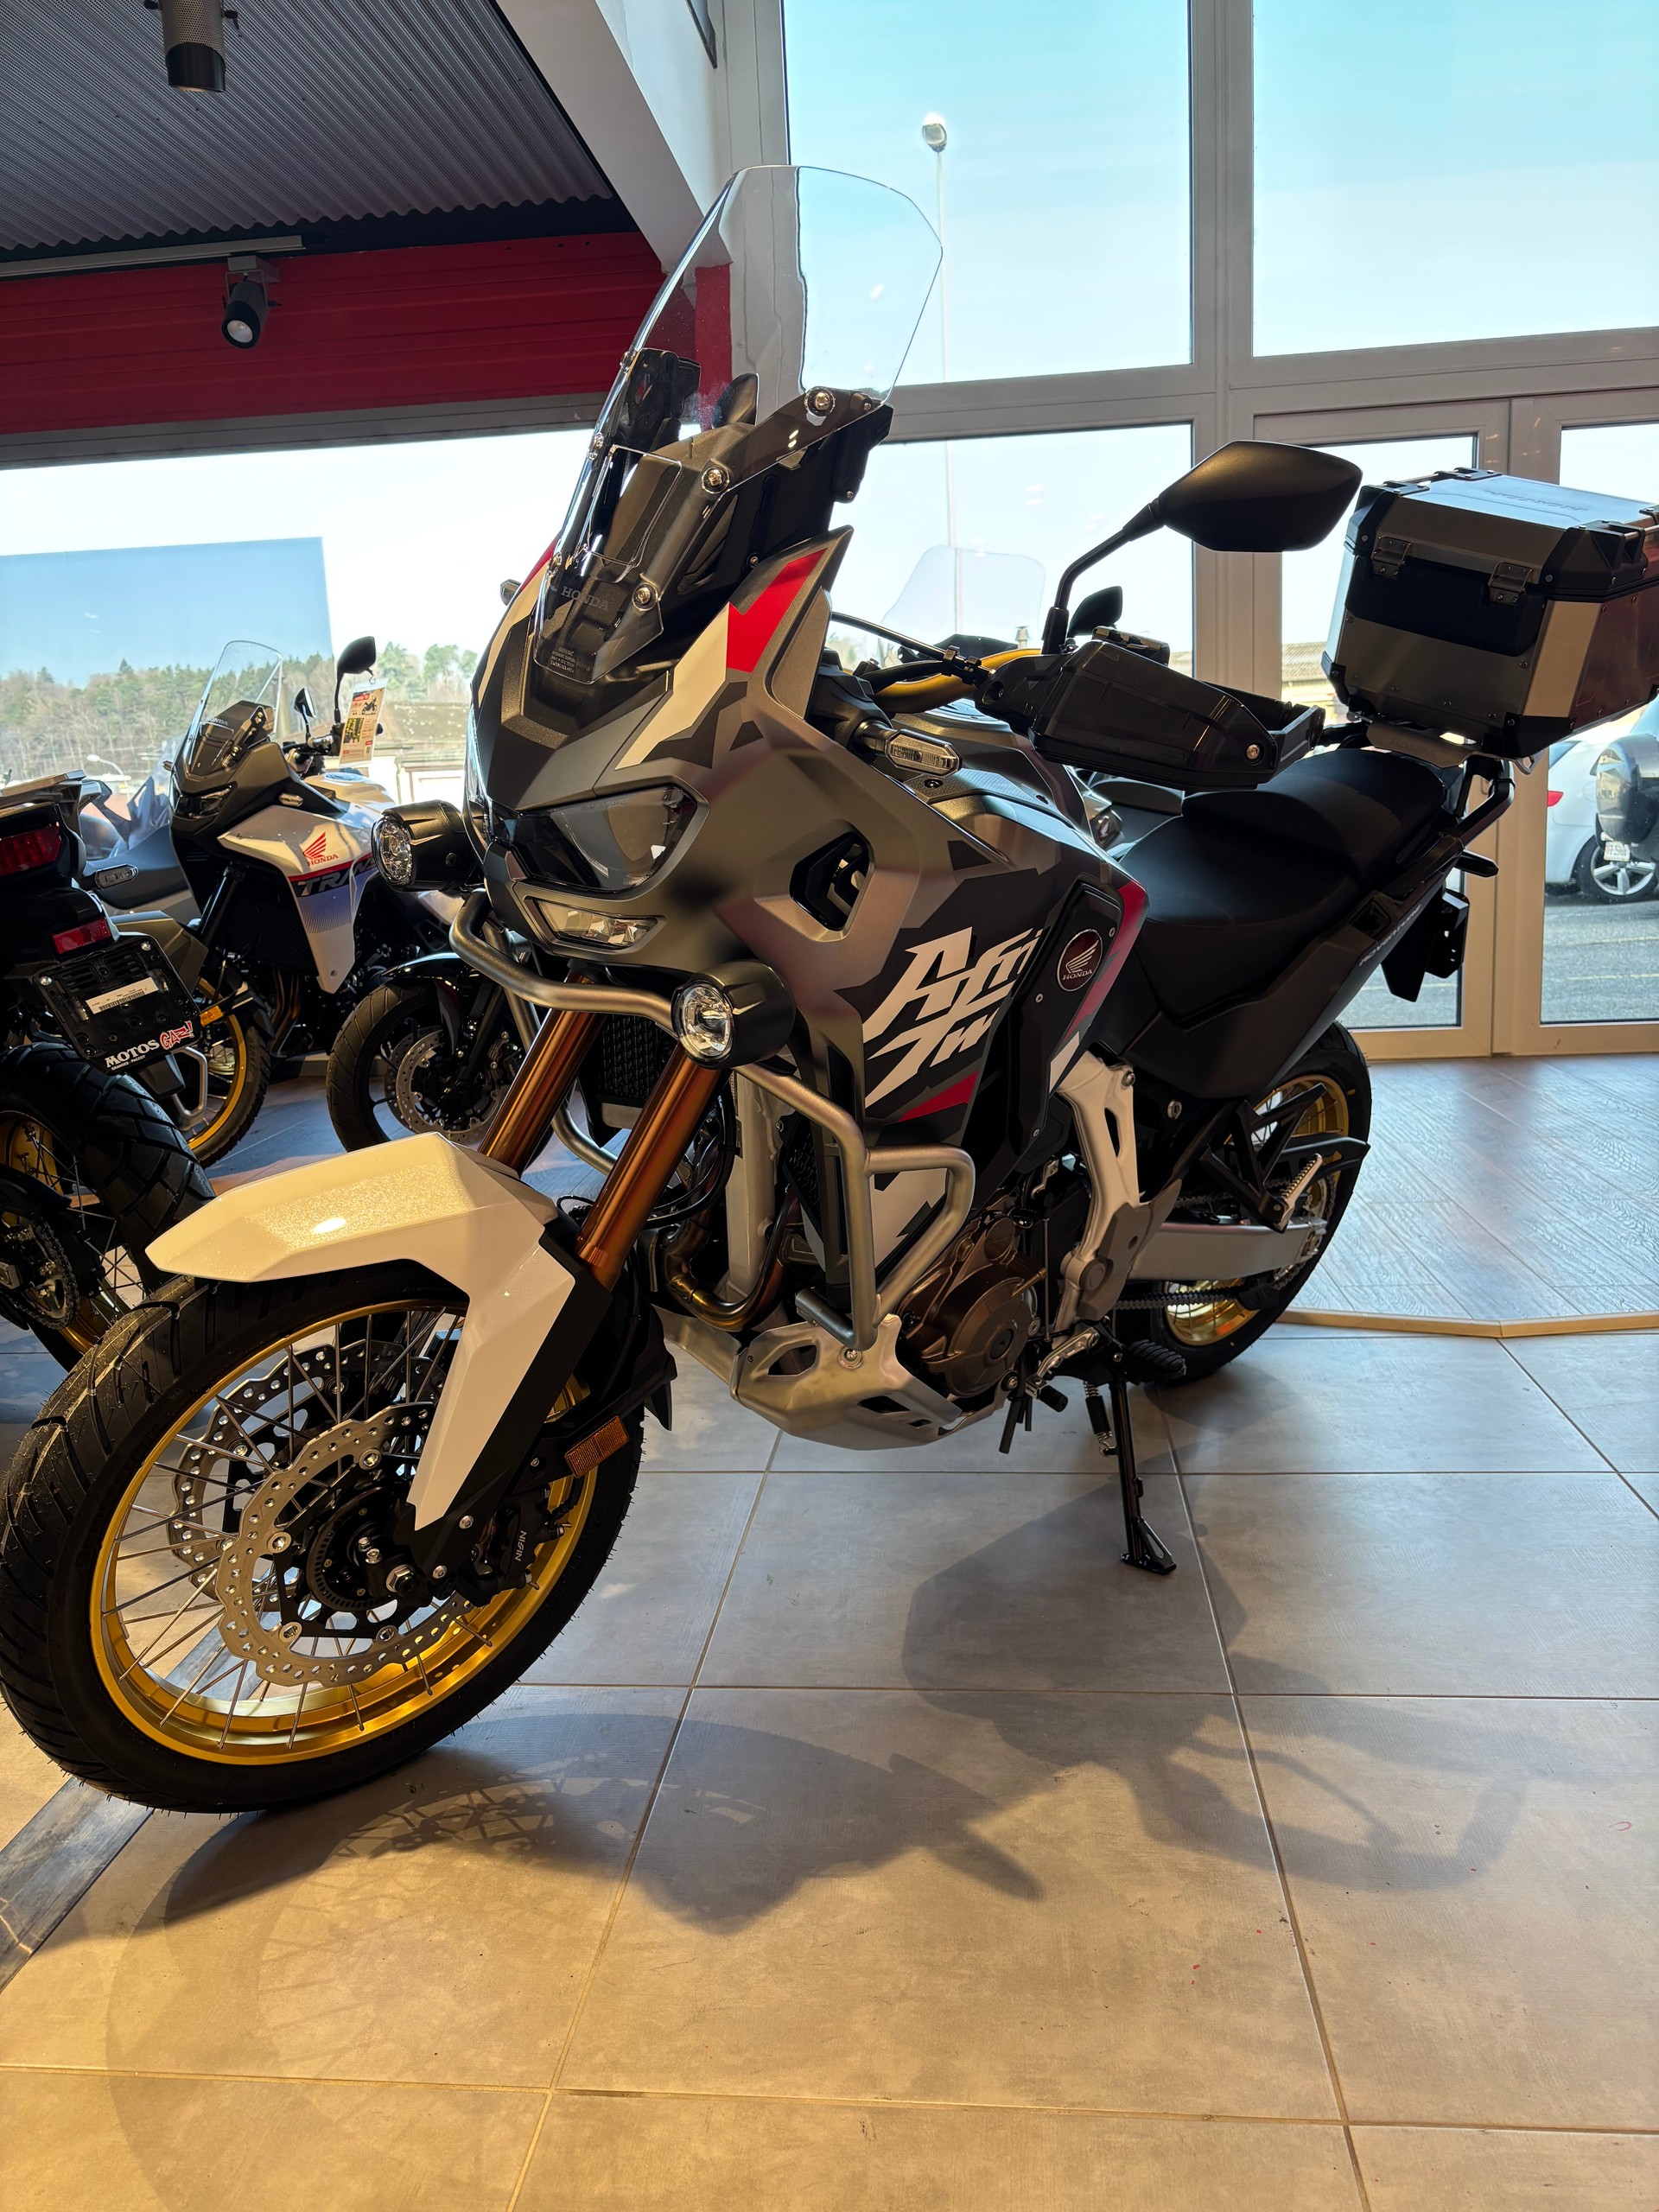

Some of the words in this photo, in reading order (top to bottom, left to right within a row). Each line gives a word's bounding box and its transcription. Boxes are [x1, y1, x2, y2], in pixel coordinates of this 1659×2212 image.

[561, 586, 609, 611] HONDA
[307, 854, 339, 867] HONDA
[1061, 969, 1093, 981] HONDA
[105, 1039, 160, 1068] MOTOS
[159, 1020, 194, 1050] GAZ!
